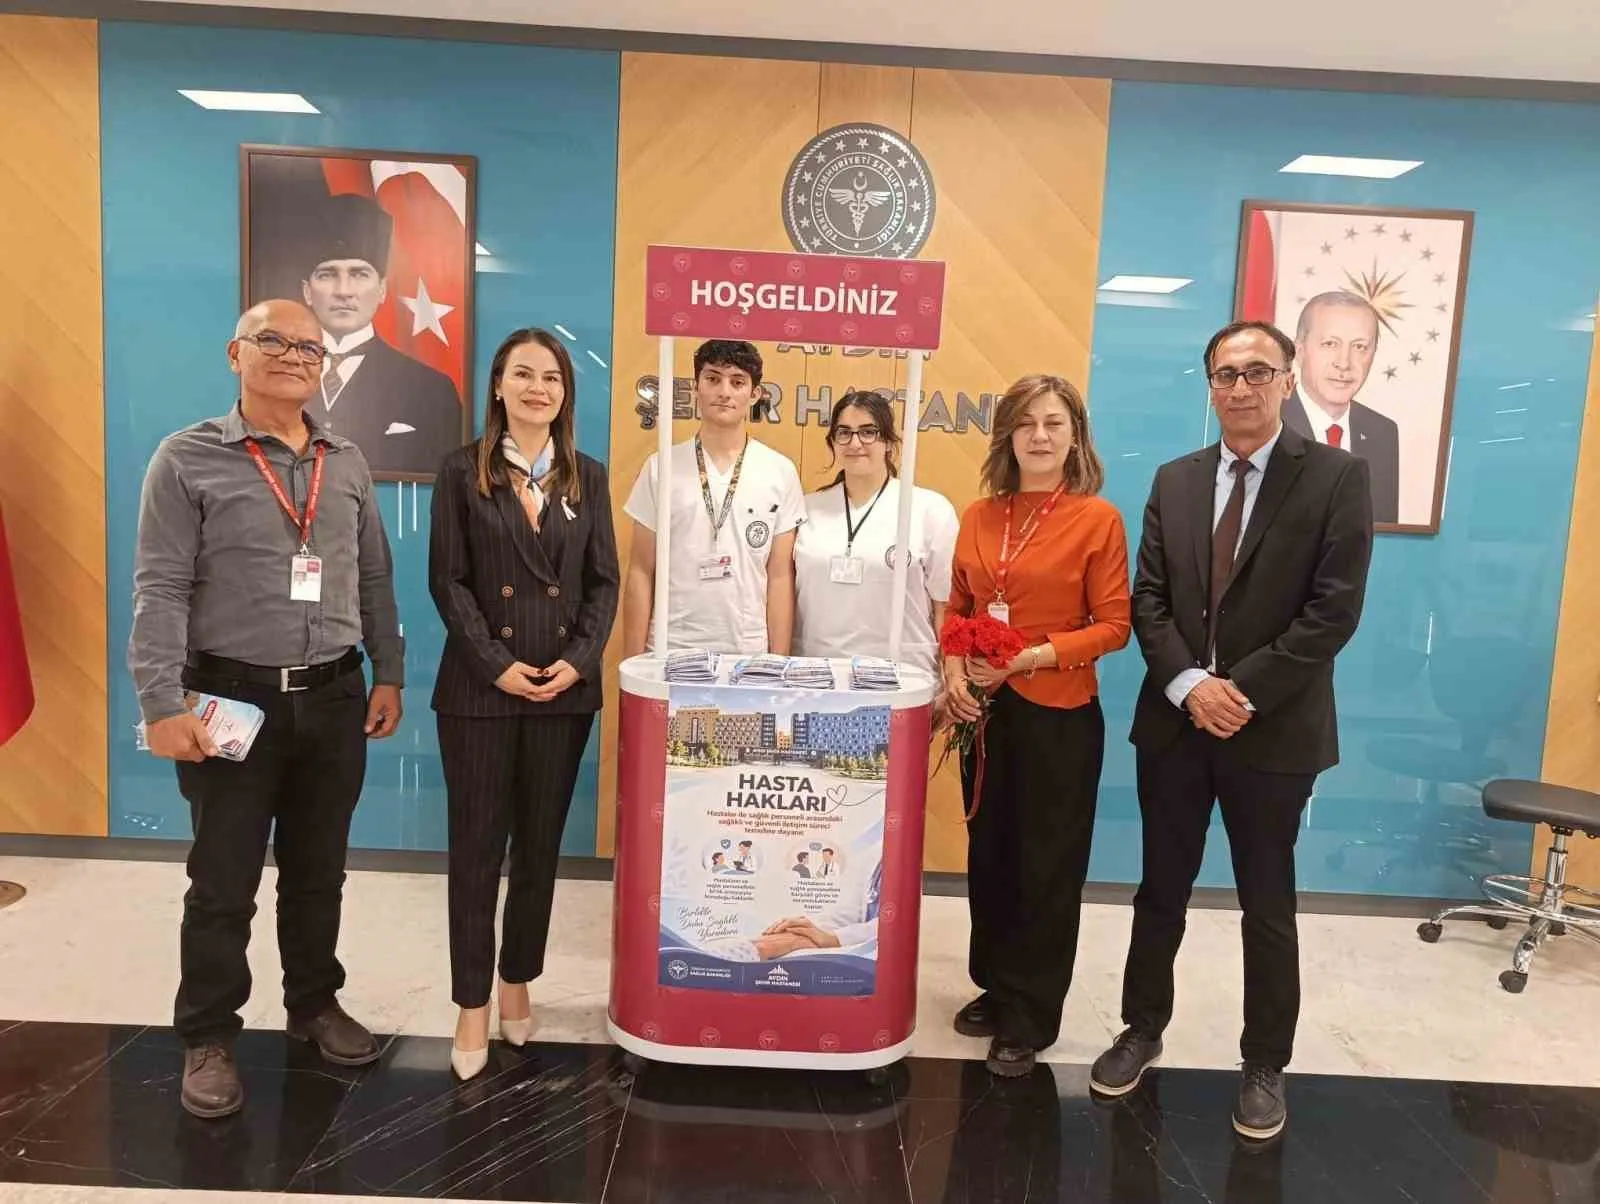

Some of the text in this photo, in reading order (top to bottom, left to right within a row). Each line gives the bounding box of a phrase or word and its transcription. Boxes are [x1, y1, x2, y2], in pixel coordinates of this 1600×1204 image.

[815, 155, 871, 198] CUMHURİYETİ
[872, 159, 900, 190] SAĞLIK
[815, 201, 838, 242] TÜRKİYE
[690, 279, 898, 316] HOŞGELDİNİZ
[738, 773, 814, 793] HASTA
[726, 791, 827, 812] HAKLARI
